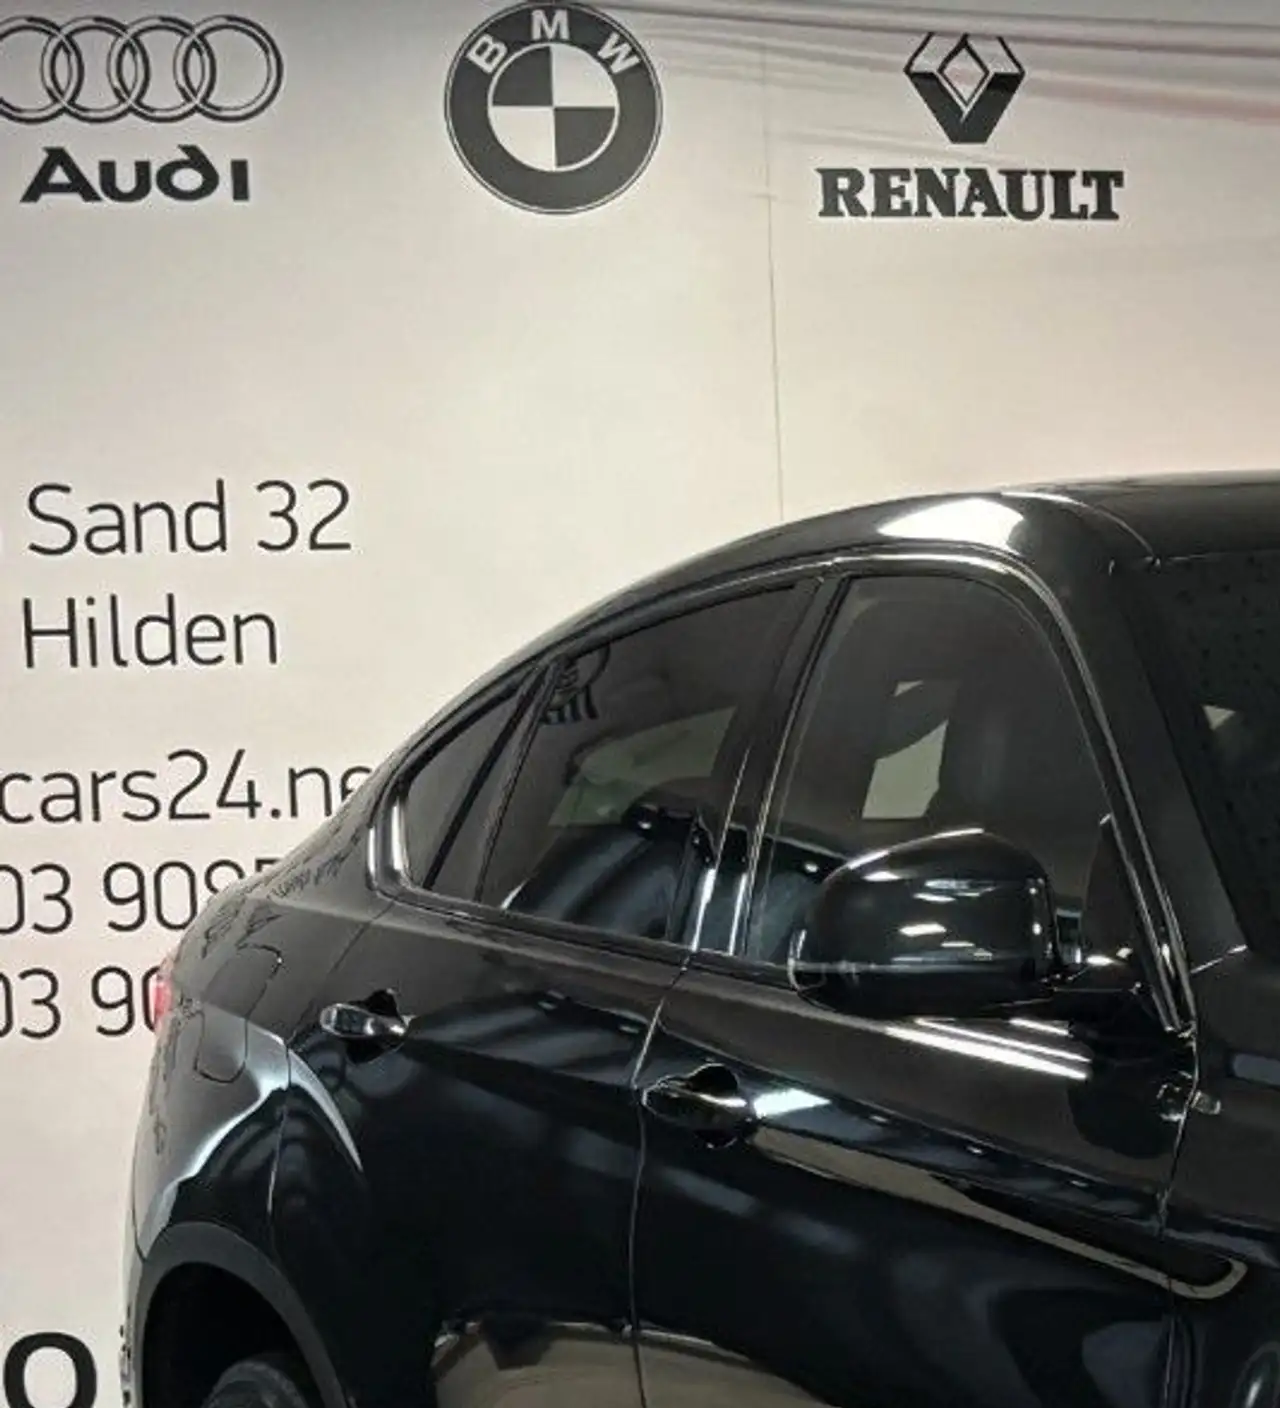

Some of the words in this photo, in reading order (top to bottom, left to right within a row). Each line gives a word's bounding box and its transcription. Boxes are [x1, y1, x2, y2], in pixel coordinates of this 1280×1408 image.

[467, 8, 643, 75] BMW
[19, 144, 250, 203] Audi
[816, 167, 1125, 221] RENAULT
[28, 478, 227, 556] Sand
[256, 479, 351, 552] 32
[23, 593, 277, 669] Hilden
[0, 967, 61, 1040] 3
